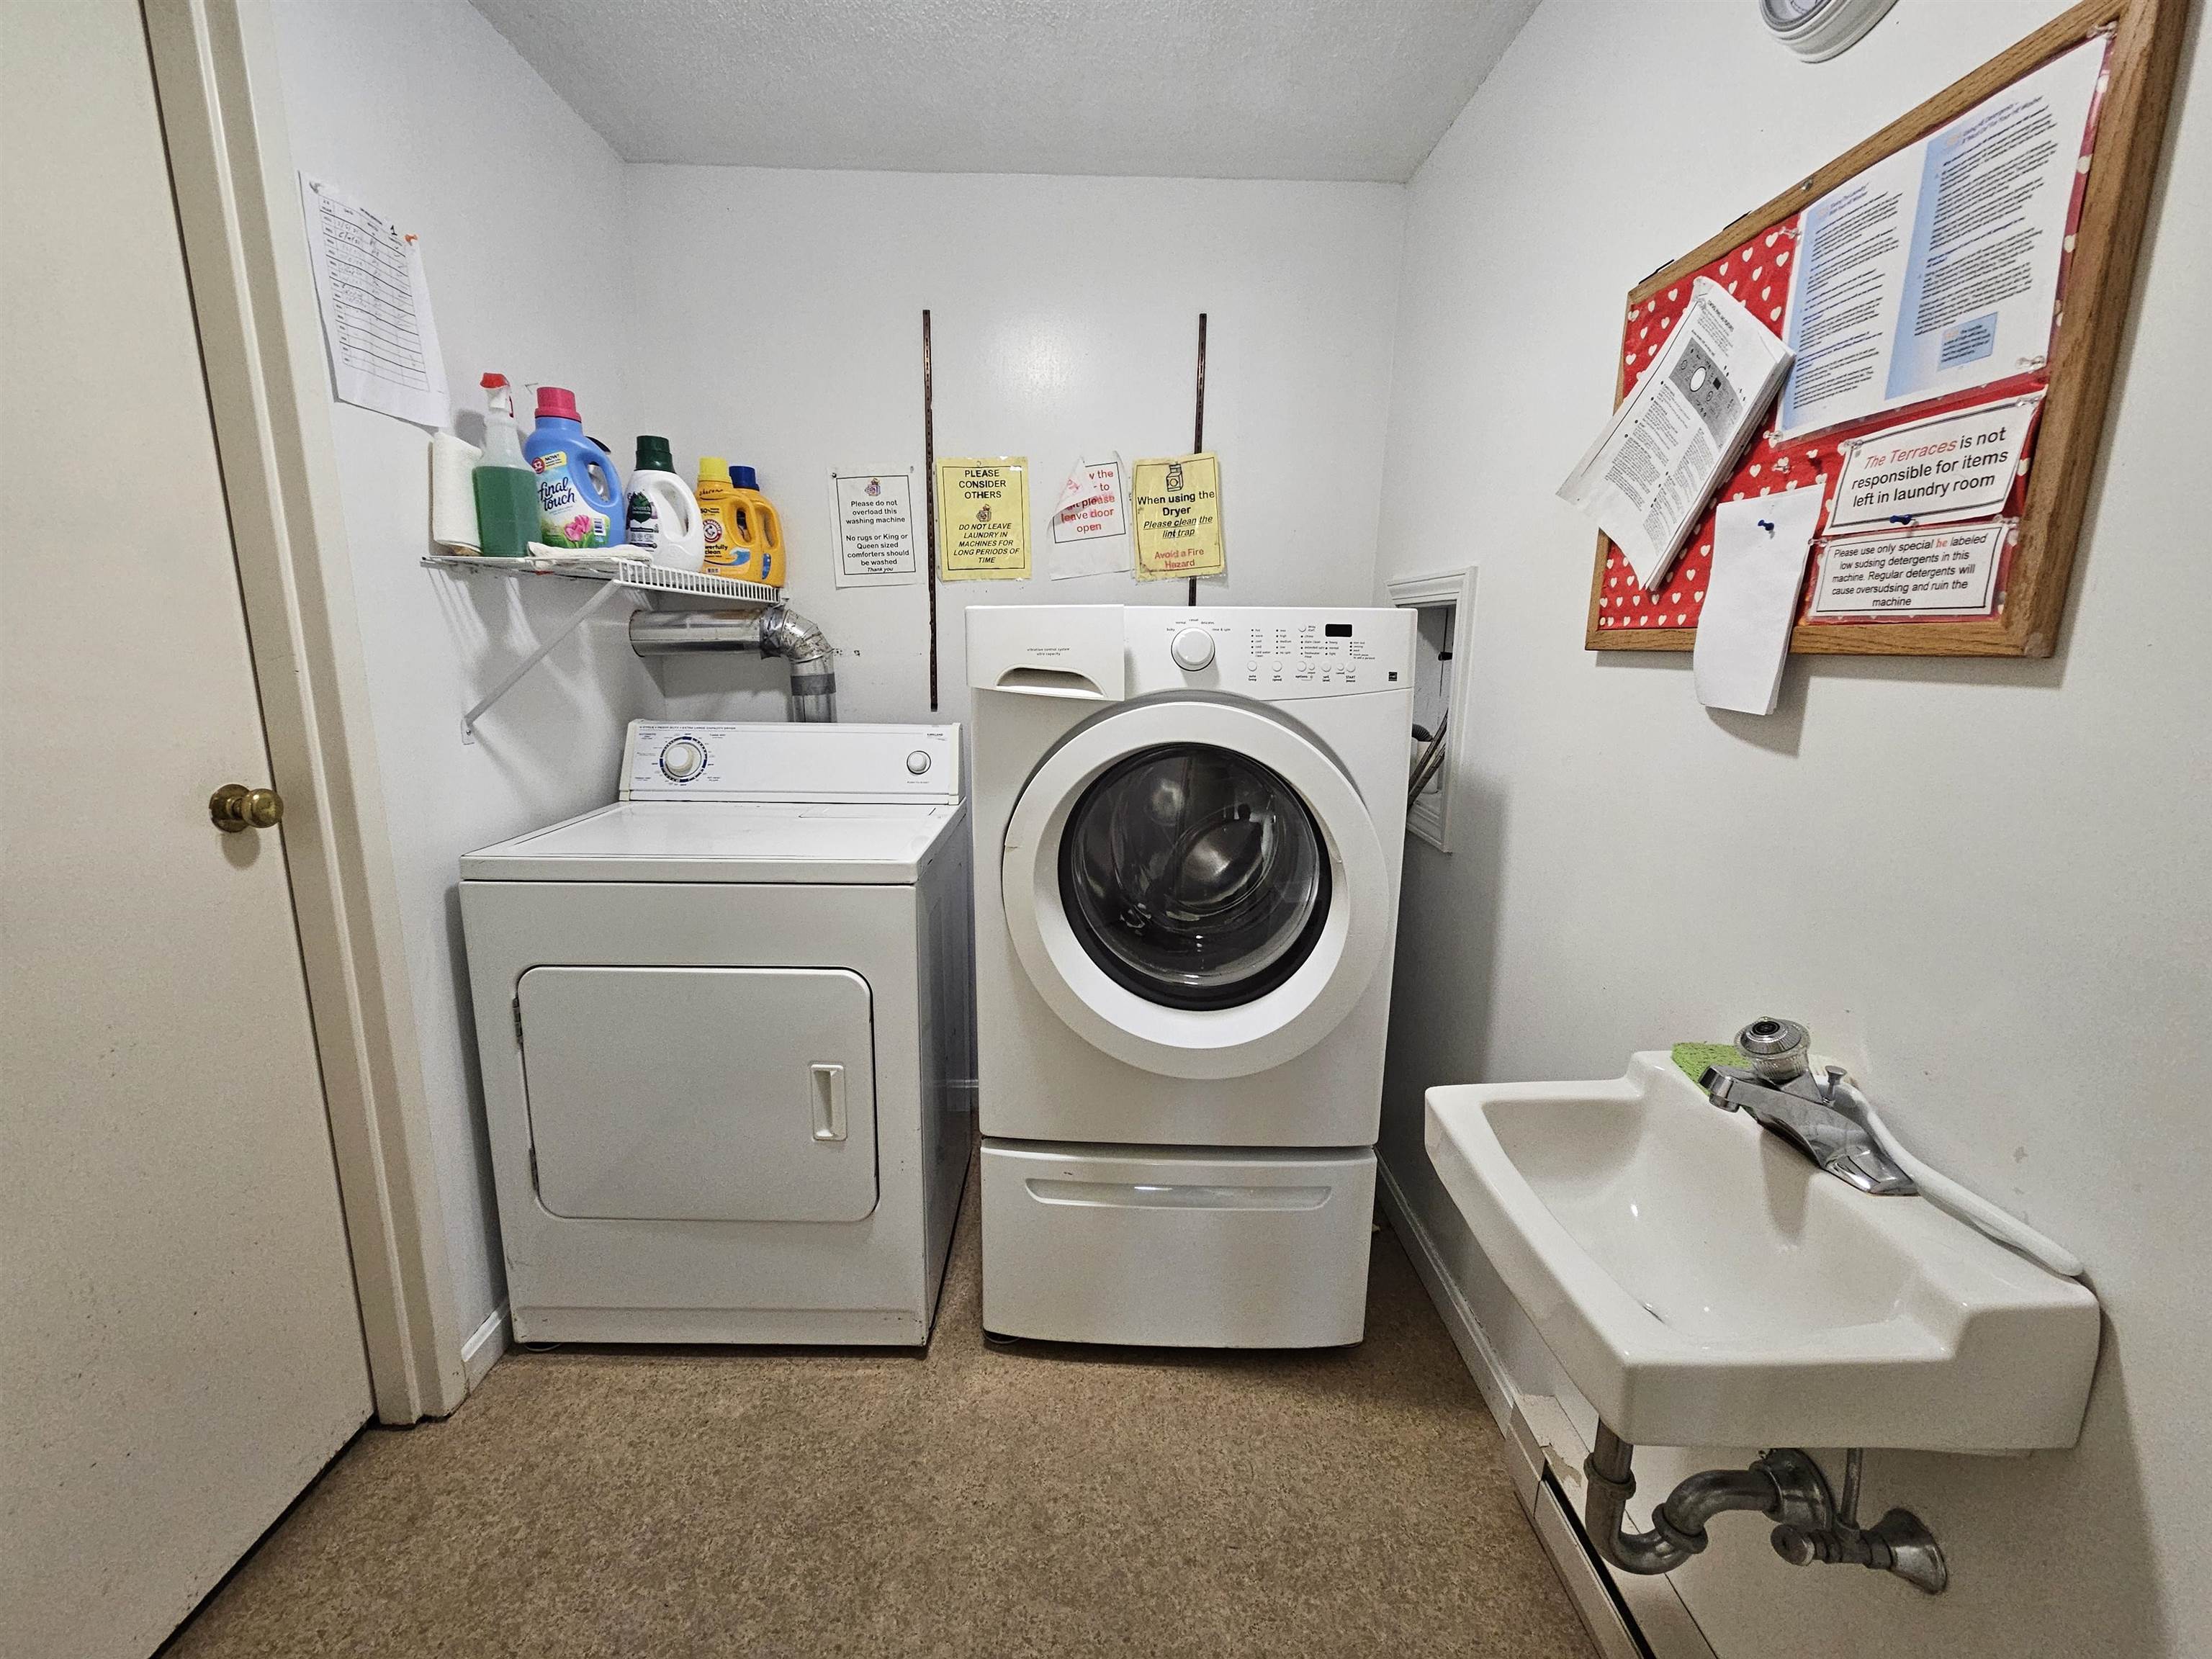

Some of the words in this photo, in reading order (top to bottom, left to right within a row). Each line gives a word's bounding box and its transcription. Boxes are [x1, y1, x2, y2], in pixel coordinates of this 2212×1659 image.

[1863, 455, 1886, 469] The
[1890, 439, 1958, 464] Terraces
[1960, 435, 1972, 449] is
[1977, 426, 2007, 446] not
[1097, 469, 1114, 479] the
[1851, 464, 1932, 490] responsible
[1936, 457, 1959, 474] for
[1961, 450, 2009, 470] items
[538, 477, 569, 500] final
[958, 480, 1007, 488] CONSIDER
[1853, 493, 1874, 508] left
[1877, 490, 1889, 503] in
[1893, 482, 1951, 502] laundry
[1953, 475, 1995, 492] room
[543, 487, 575, 511] touch
[1082, 495, 1115, 508] please
[1137, 496, 1166, 505] When
[1168, 493, 1196, 503] using
[1198, 490, 1215, 500] the
[1061, 512, 1088, 523] leave
[1089, 508, 1115, 518] door
[1162, 506, 1192, 518] Dryer
[1076, 523, 1102, 534] open
[1174, 518, 1197, 526] clean
[1199, 516, 1213, 524] the
[1177, 529, 1195, 538] trap
[1833, 547, 1859, 559] Please
[1861, 547, 1875, 556] use
[1877, 543, 1896, 556] only
[1898, 539, 1935, 554] special
[1936, 538, 1948, 549] he
[1950, 533, 1989, 547] labeled
[1154, 550, 1179, 559] Avoid
[1839, 560, 1853, 570] low
[1855, 557, 1885, 570] sudsing
[1888, 553, 1939, 567] detergents
[1941, 552, 1951, 562] in
[1952, 549, 1970, 561] this
[1164, 559, 1195, 569] Hazard
[1868, 569, 1903, 582] Regular
[1906, 564, 1956, 580] detergents
[1959, 564, 1976, 575] will
[1832, 586, 1855, 595] cause
[1856, 582, 1909, 595] oversudsing
[1911, 582, 1929, 592] and
[1931, 580, 1948, 590] ruin
[1951, 579, 1969, 590] the
[1872, 597, 1912, 607] machine
